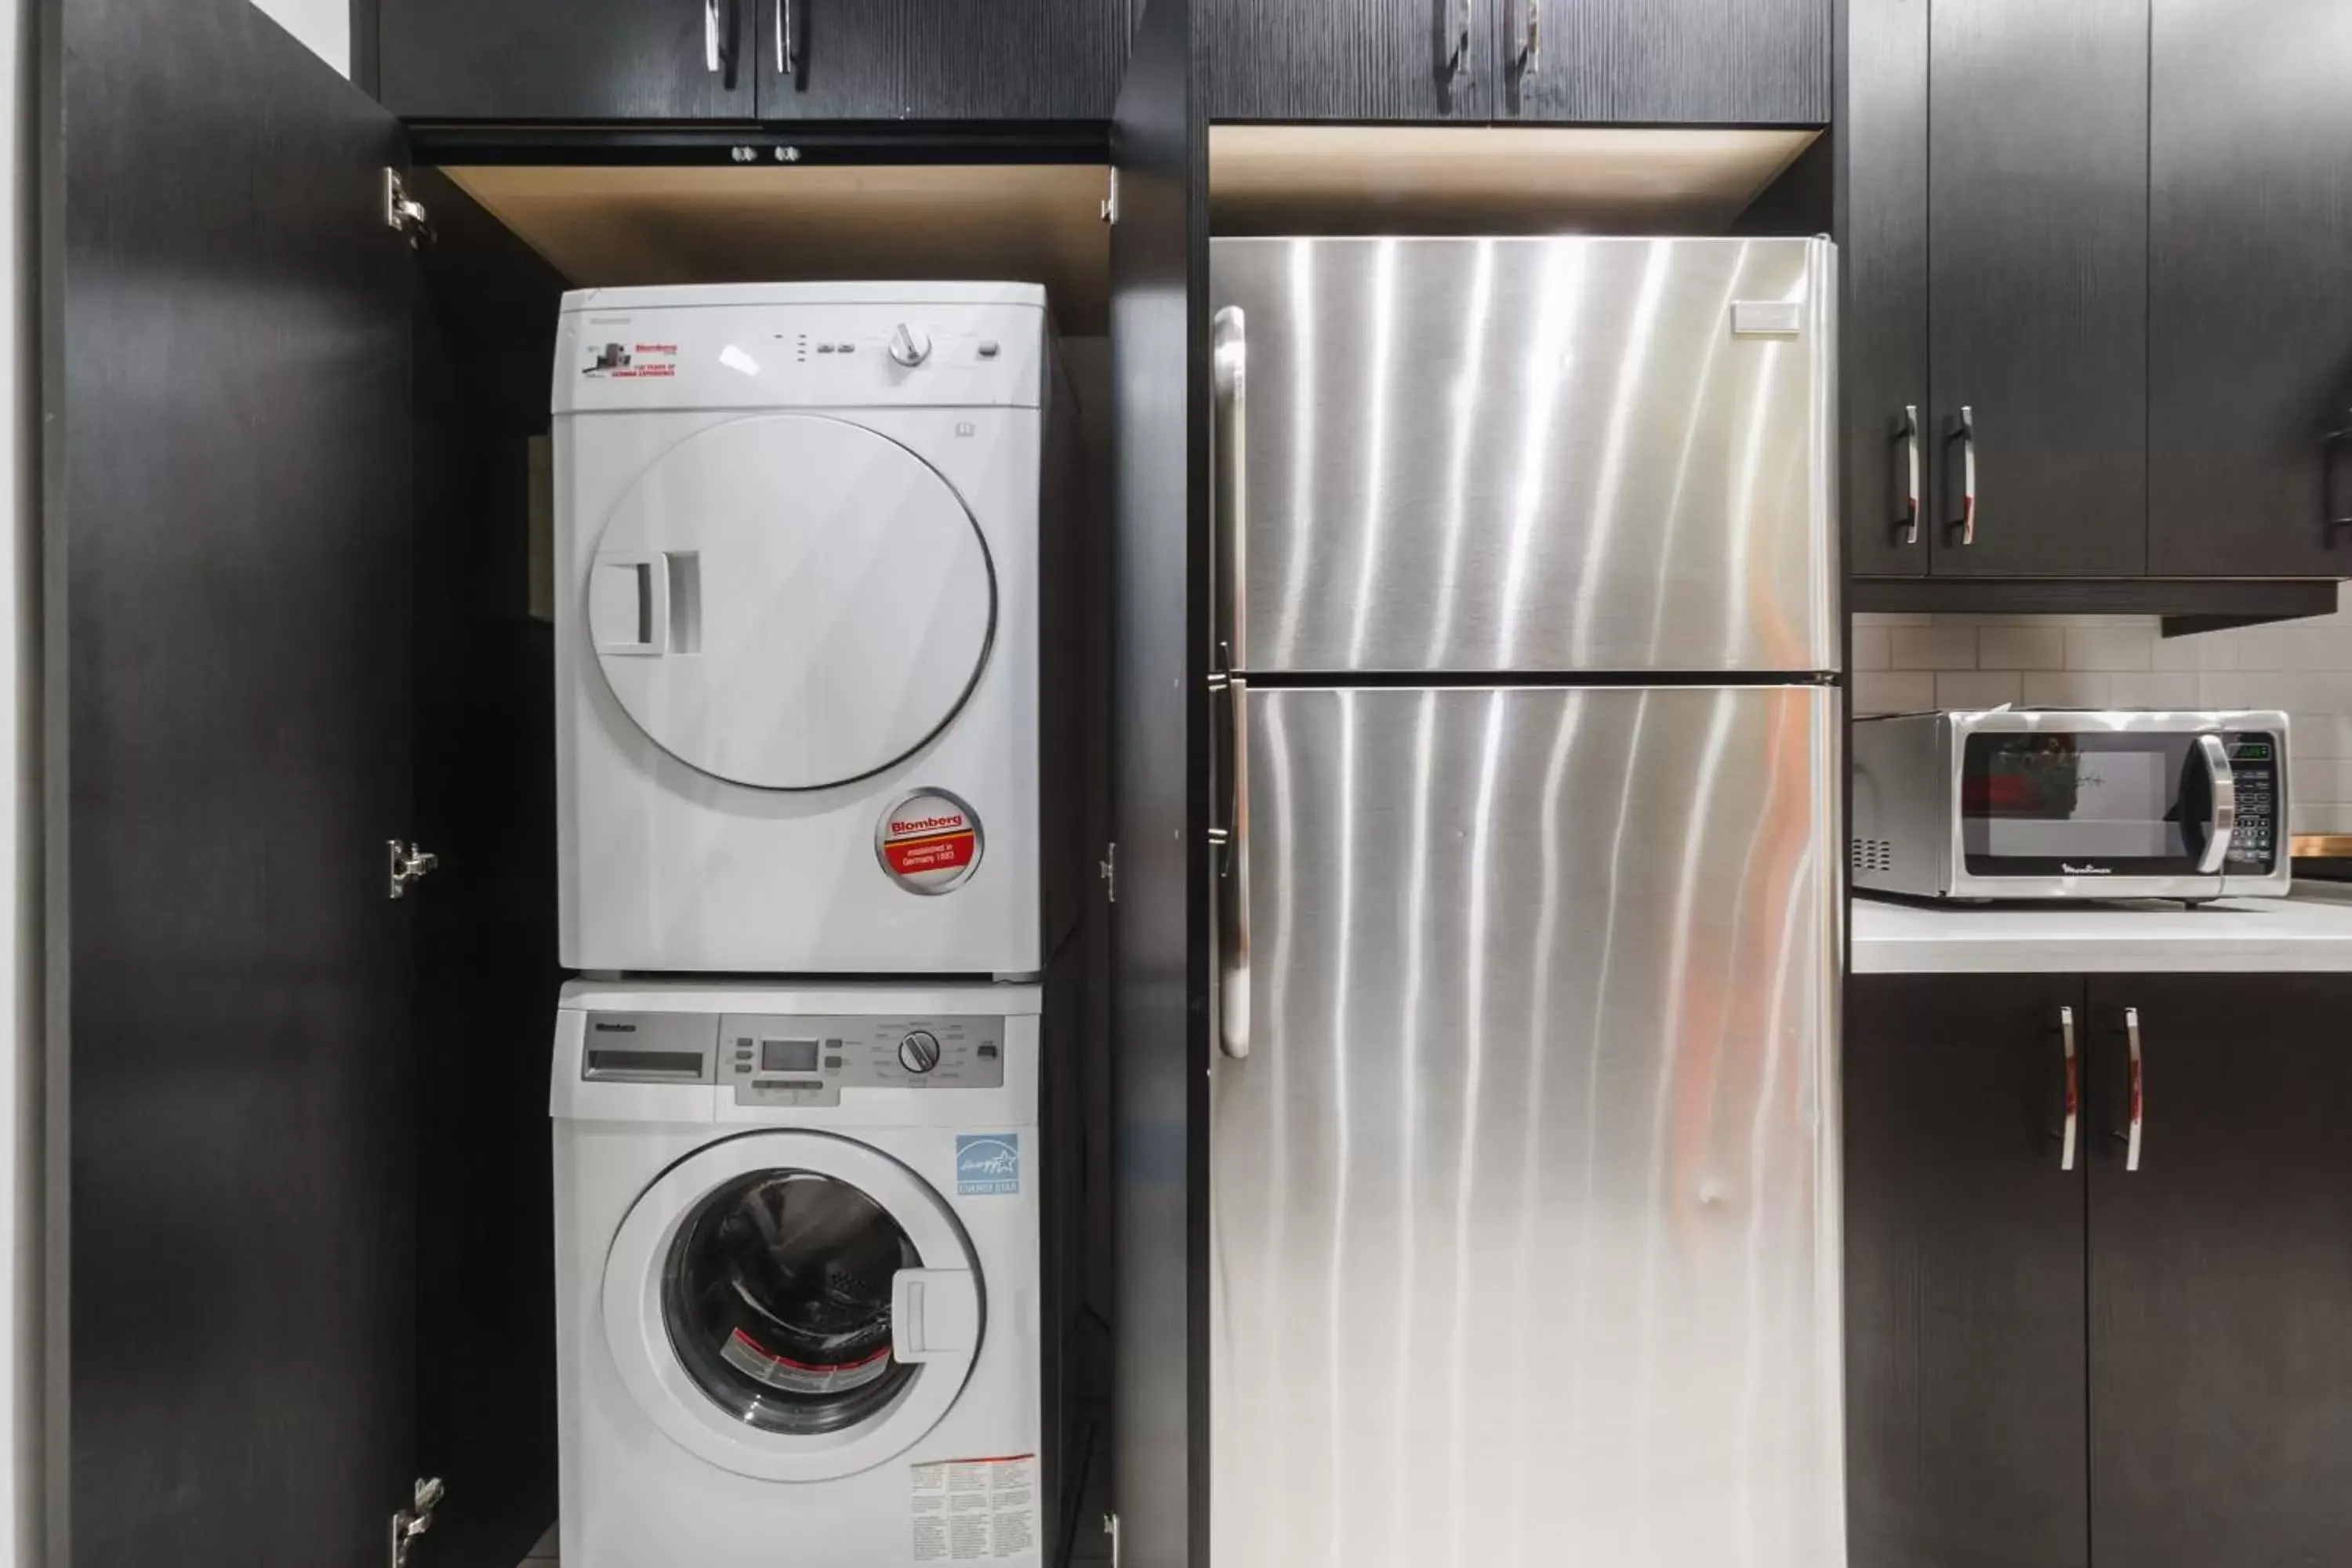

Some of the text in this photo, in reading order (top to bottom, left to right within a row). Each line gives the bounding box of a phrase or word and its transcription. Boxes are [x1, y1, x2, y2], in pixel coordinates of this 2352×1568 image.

[891, 815, 962, 832] Blomberg
[902, 851, 955, 866] Germany 1883
[995, 1181, 1018, 1193] STAR
